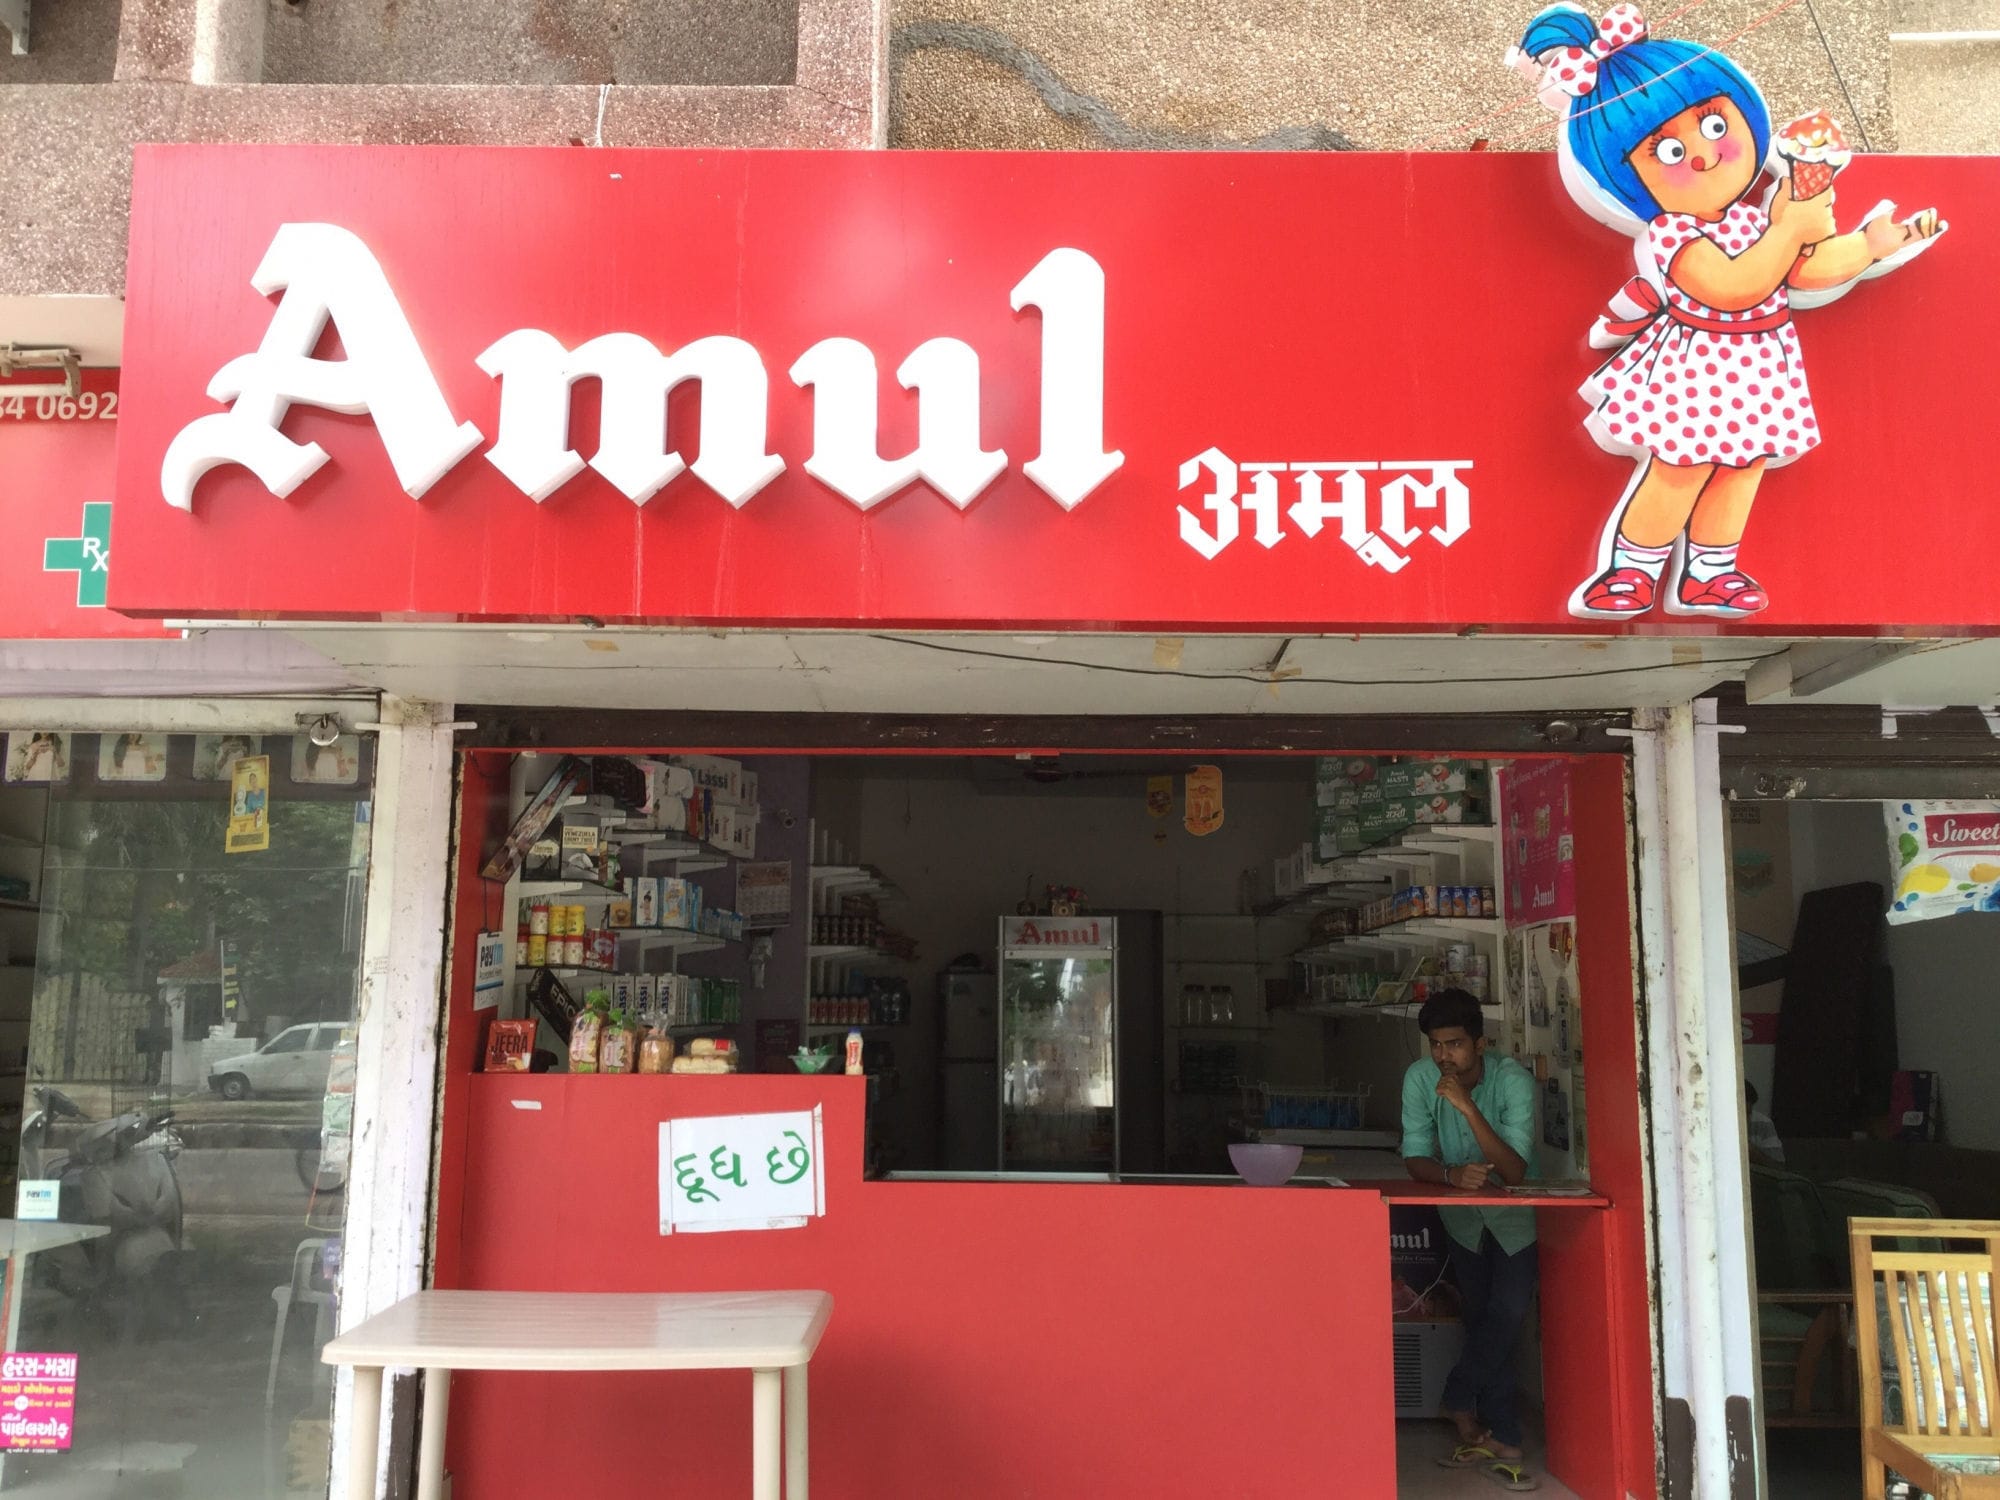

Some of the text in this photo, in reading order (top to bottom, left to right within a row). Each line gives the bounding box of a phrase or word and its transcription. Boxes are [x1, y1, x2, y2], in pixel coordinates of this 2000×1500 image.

[160, 222, 1126, 513] Amul
[36, 391, 118, 420] 0692
[1176, 446, 1474, 573] अमूल
[1387, 775, 1409, 784] MASTI
[1532, 880, 1555, 910] Amul
[1013, 920, 1101, 946] Amul
[491, 1033, 528, 1054] JEERA
[765, 1130, 811, 1185] છે
[1391, 1227, 1431, 1249] mul
[2, 1356, 77, 1378] હરસ-મસા
